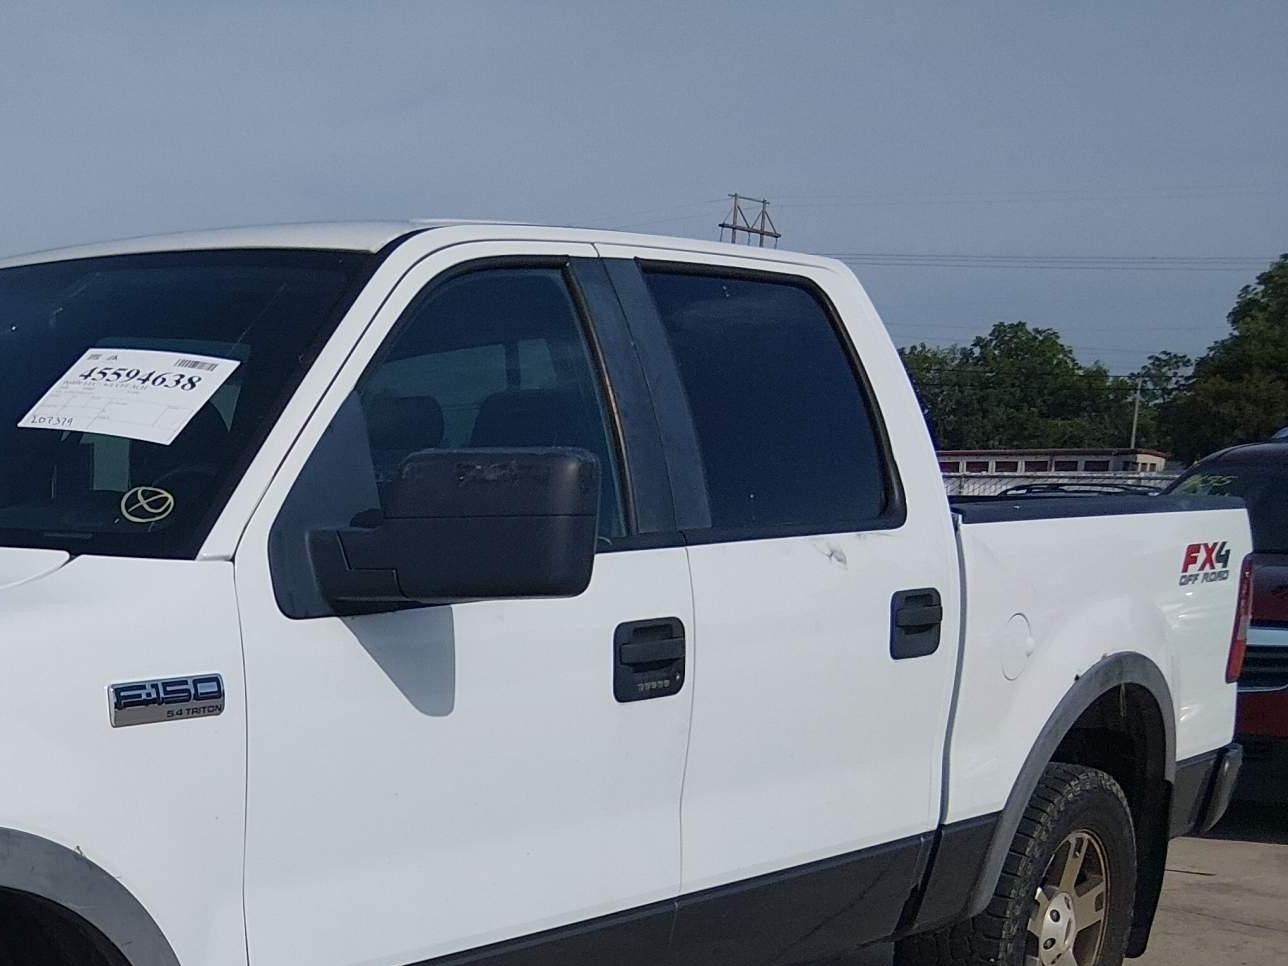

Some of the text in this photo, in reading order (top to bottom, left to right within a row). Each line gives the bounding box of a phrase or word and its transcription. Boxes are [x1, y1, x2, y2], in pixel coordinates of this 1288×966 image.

[79, 366, 202, 391] 45594638
[1181, 541, 1230, 573] FX4
[1179, 574, 1200, 586] OFF
[185, 704, 222, 716] TRITON
